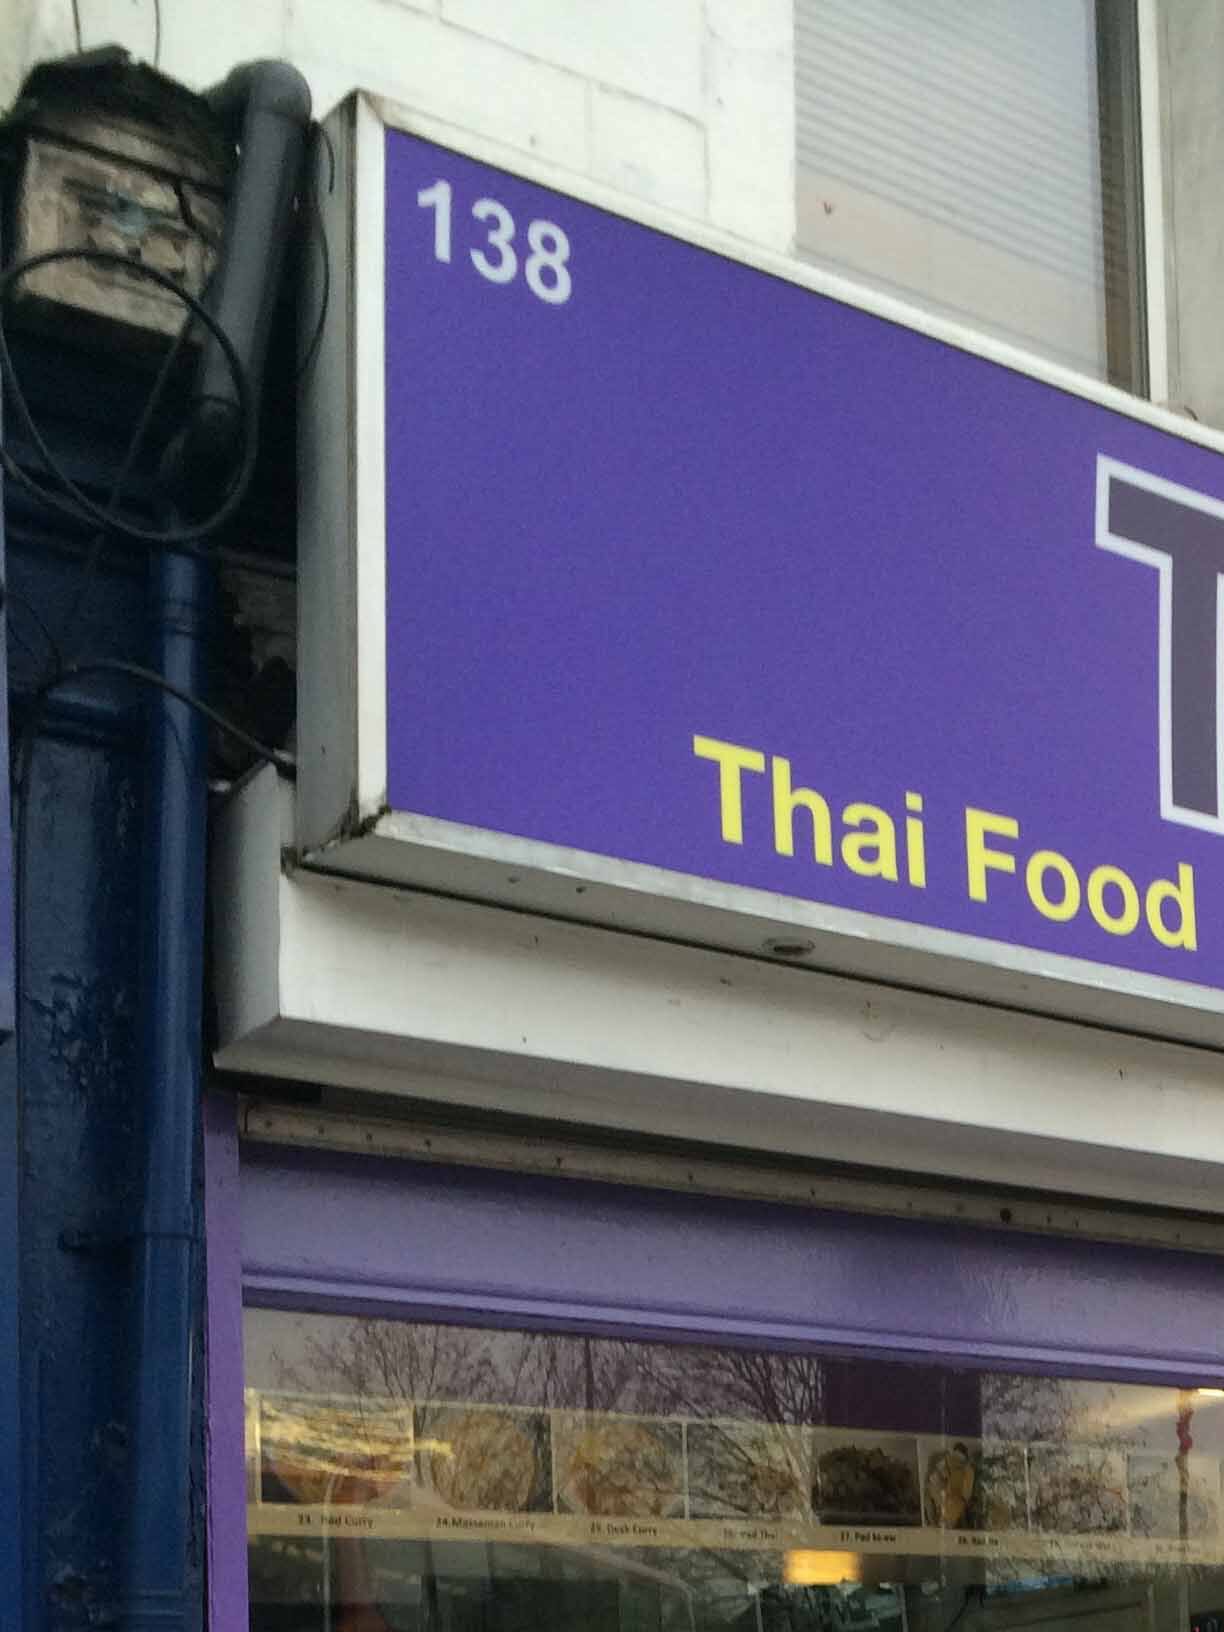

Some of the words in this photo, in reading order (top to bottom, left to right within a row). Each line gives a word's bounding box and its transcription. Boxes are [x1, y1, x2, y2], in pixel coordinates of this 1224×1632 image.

[417, 179, 572, 305] 138
[693, 734, 926, 889] Thai
[965, 807, 1198, 952] Food
